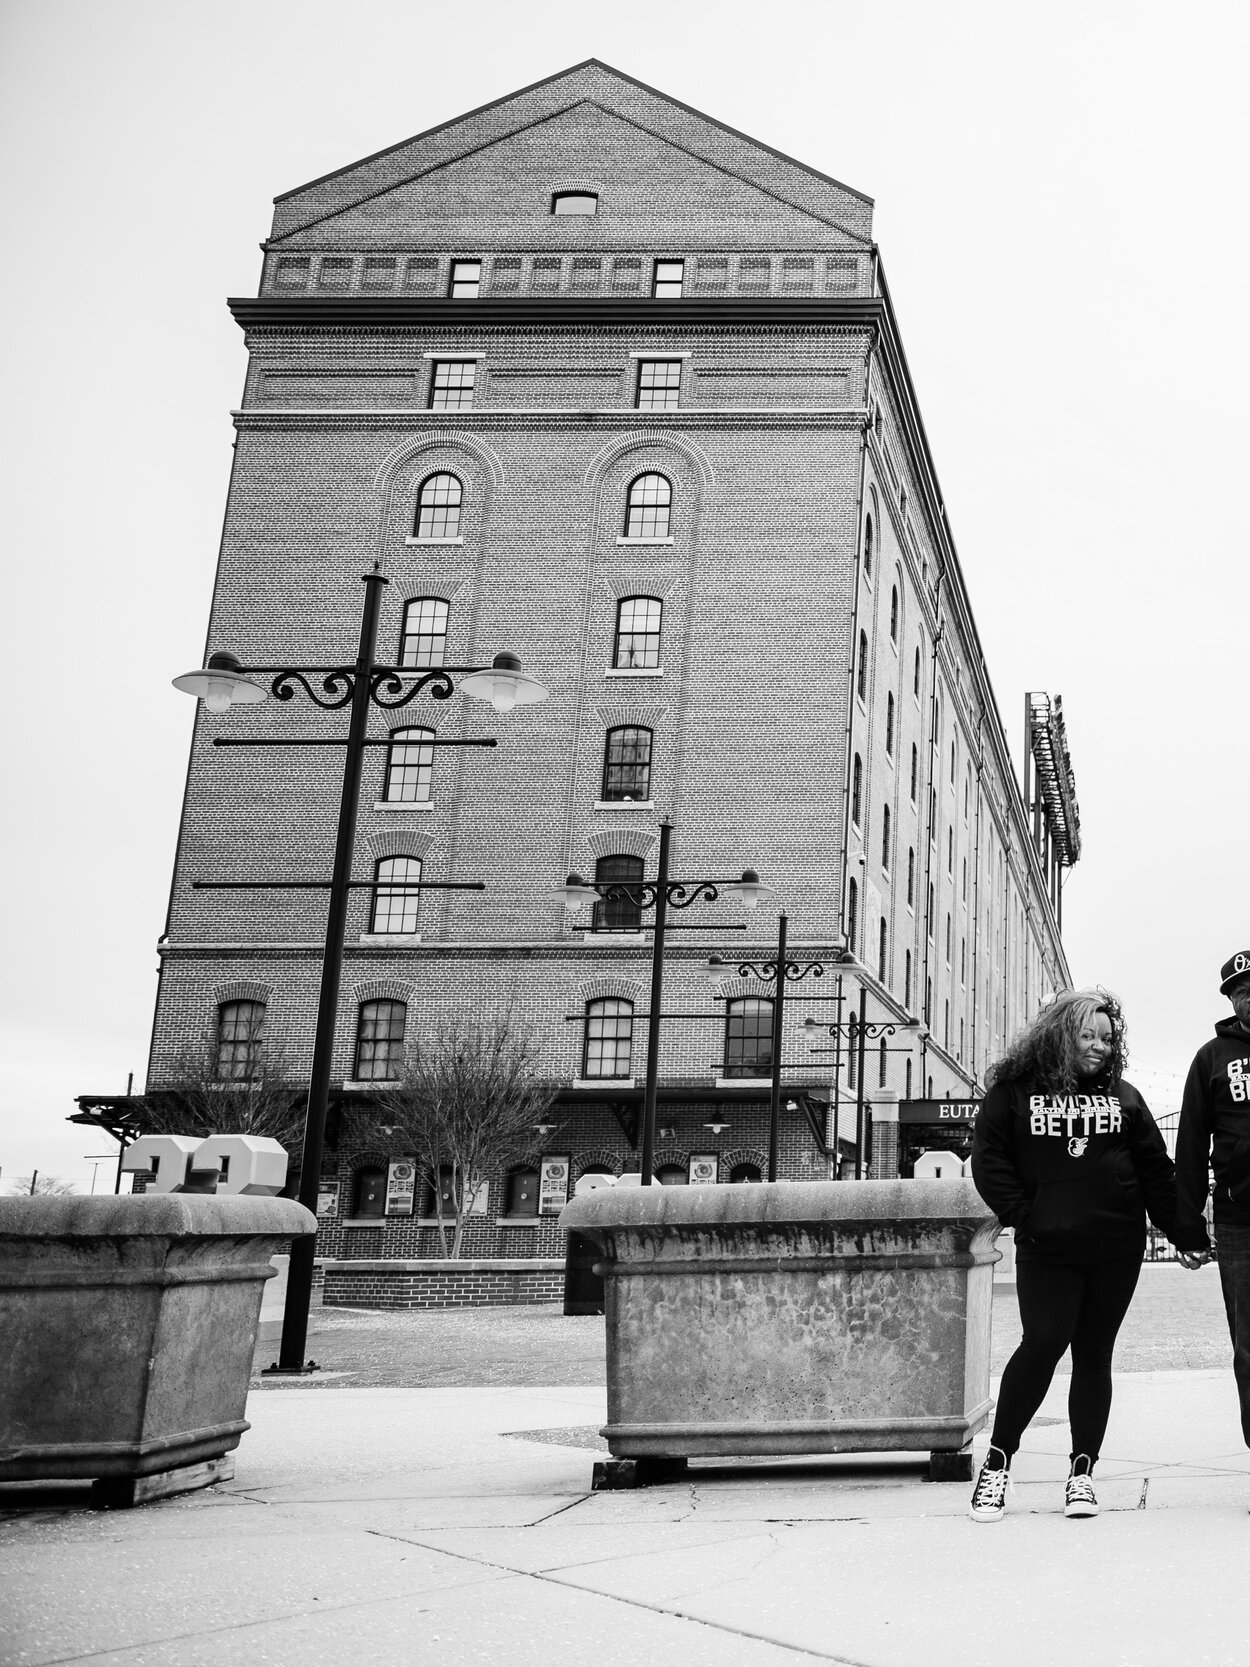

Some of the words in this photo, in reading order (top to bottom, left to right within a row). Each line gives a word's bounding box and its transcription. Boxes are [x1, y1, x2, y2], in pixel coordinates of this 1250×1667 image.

[938, 1104, 980, 1118] EUTA
[1030, 1094, 1121, 1111] B'MORE
[1030, 1112, 1122, 1137] BETTER
